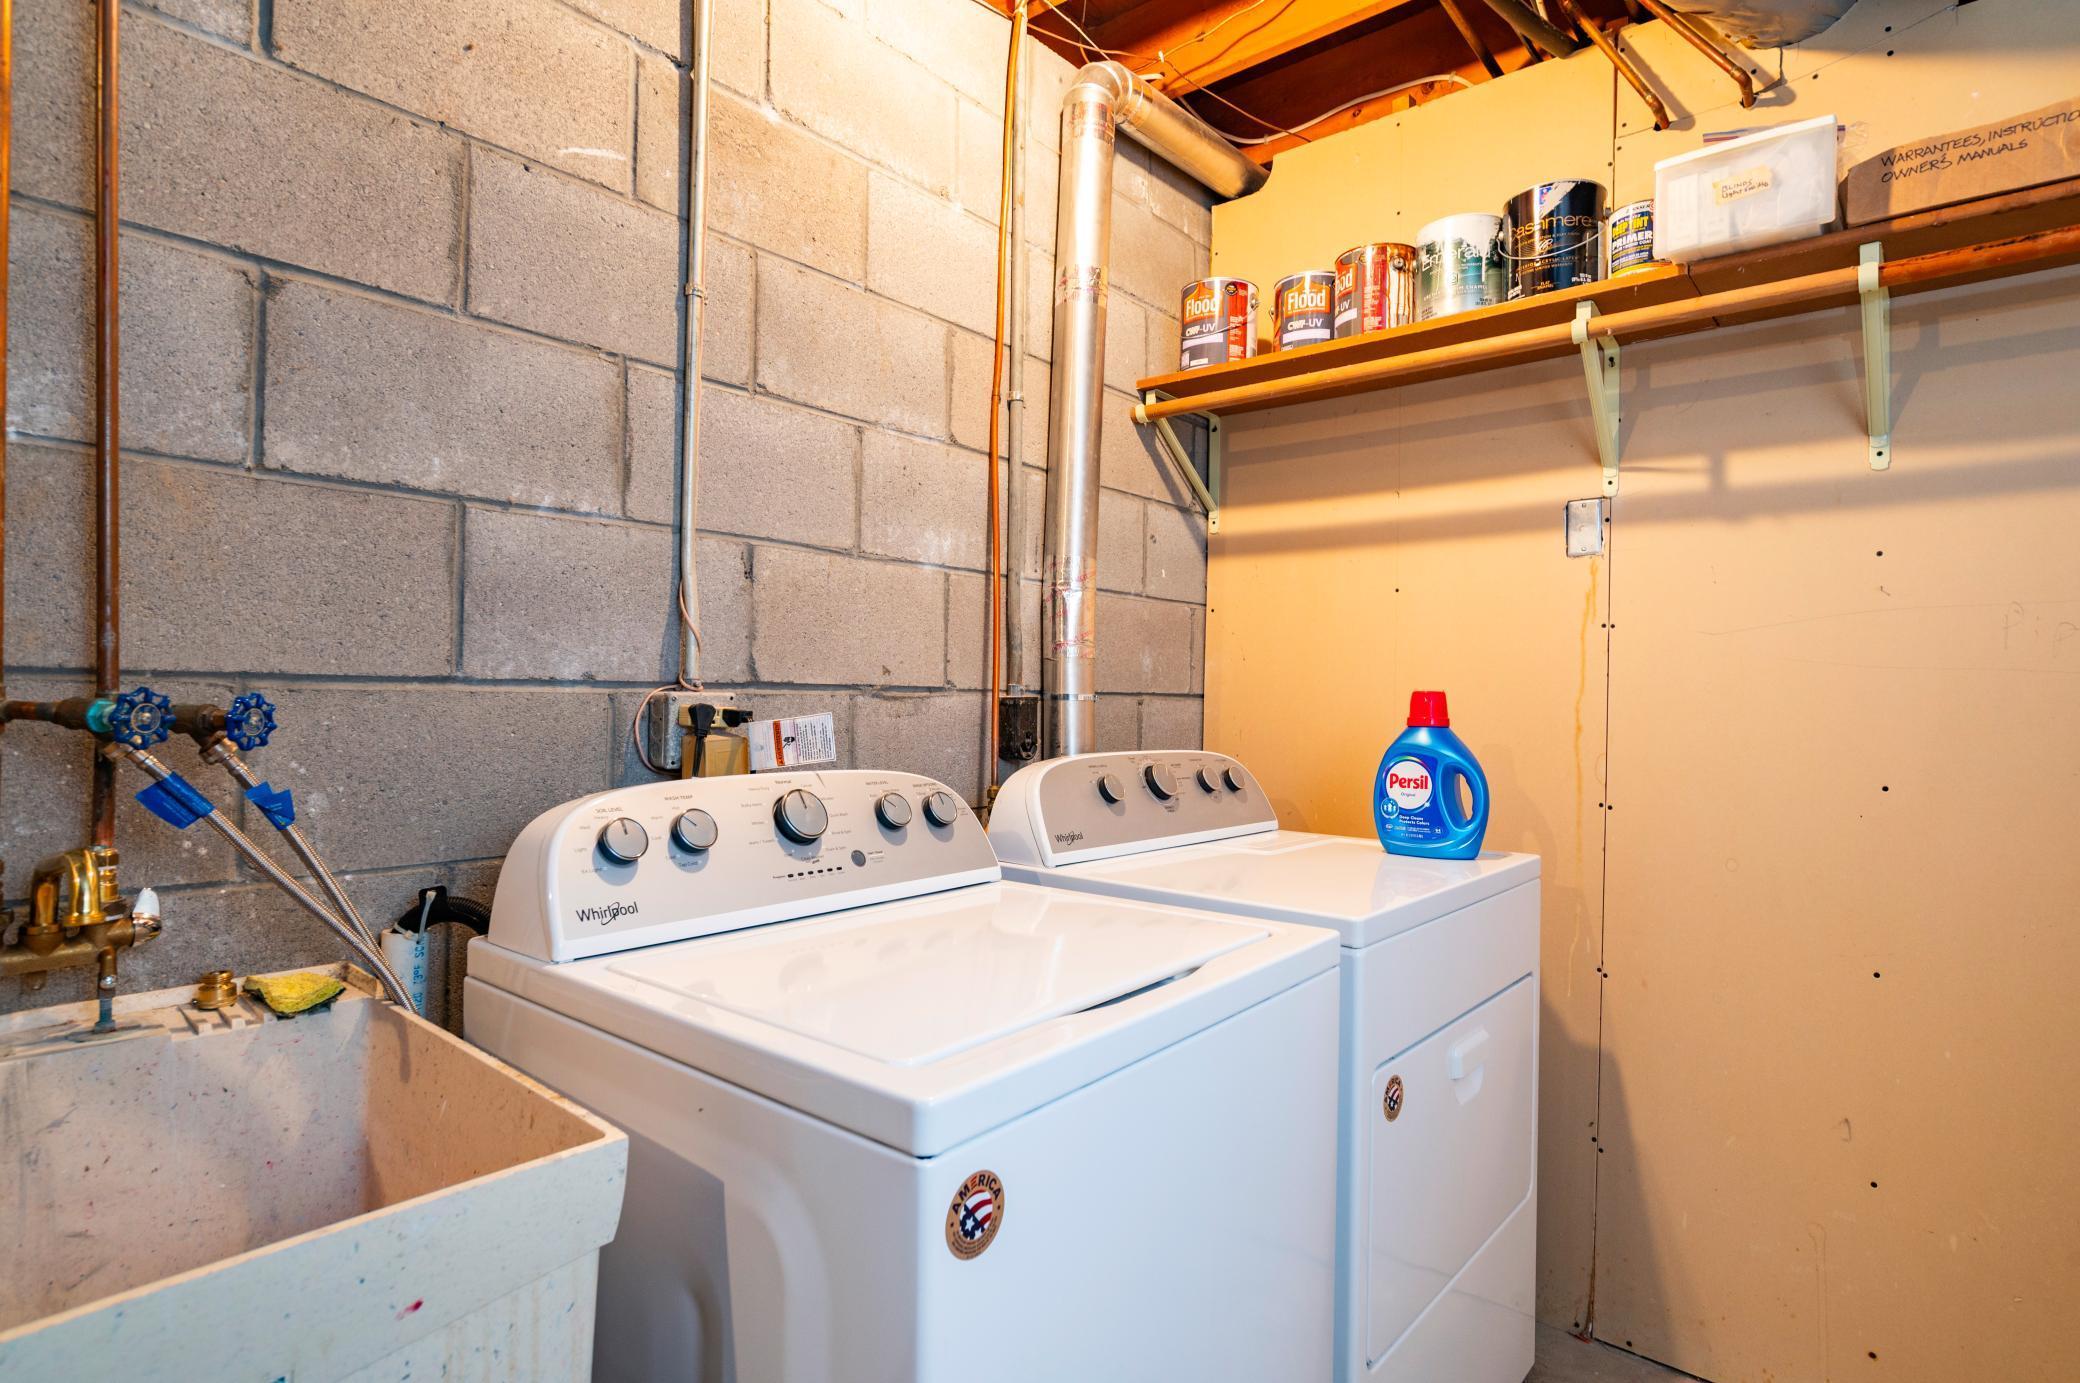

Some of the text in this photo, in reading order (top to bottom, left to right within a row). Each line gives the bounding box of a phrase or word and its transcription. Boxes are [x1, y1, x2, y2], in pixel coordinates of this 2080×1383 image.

[1881, 133, 1986, 167] WARRANTEES,
[1881, 139, 2028, 183] OWNER'S MANUALS
[1612, 230, 1653, 251] PRIMER
[1287, 288, 1326, 310] Flood
[1390, 773, 1428, 789] Persil
[1055, 831, 1083, 845] Whirlpool
[576, 902, 639, 925] Whirlpool
[952, 1174, 1002, 1215] AMERICA
